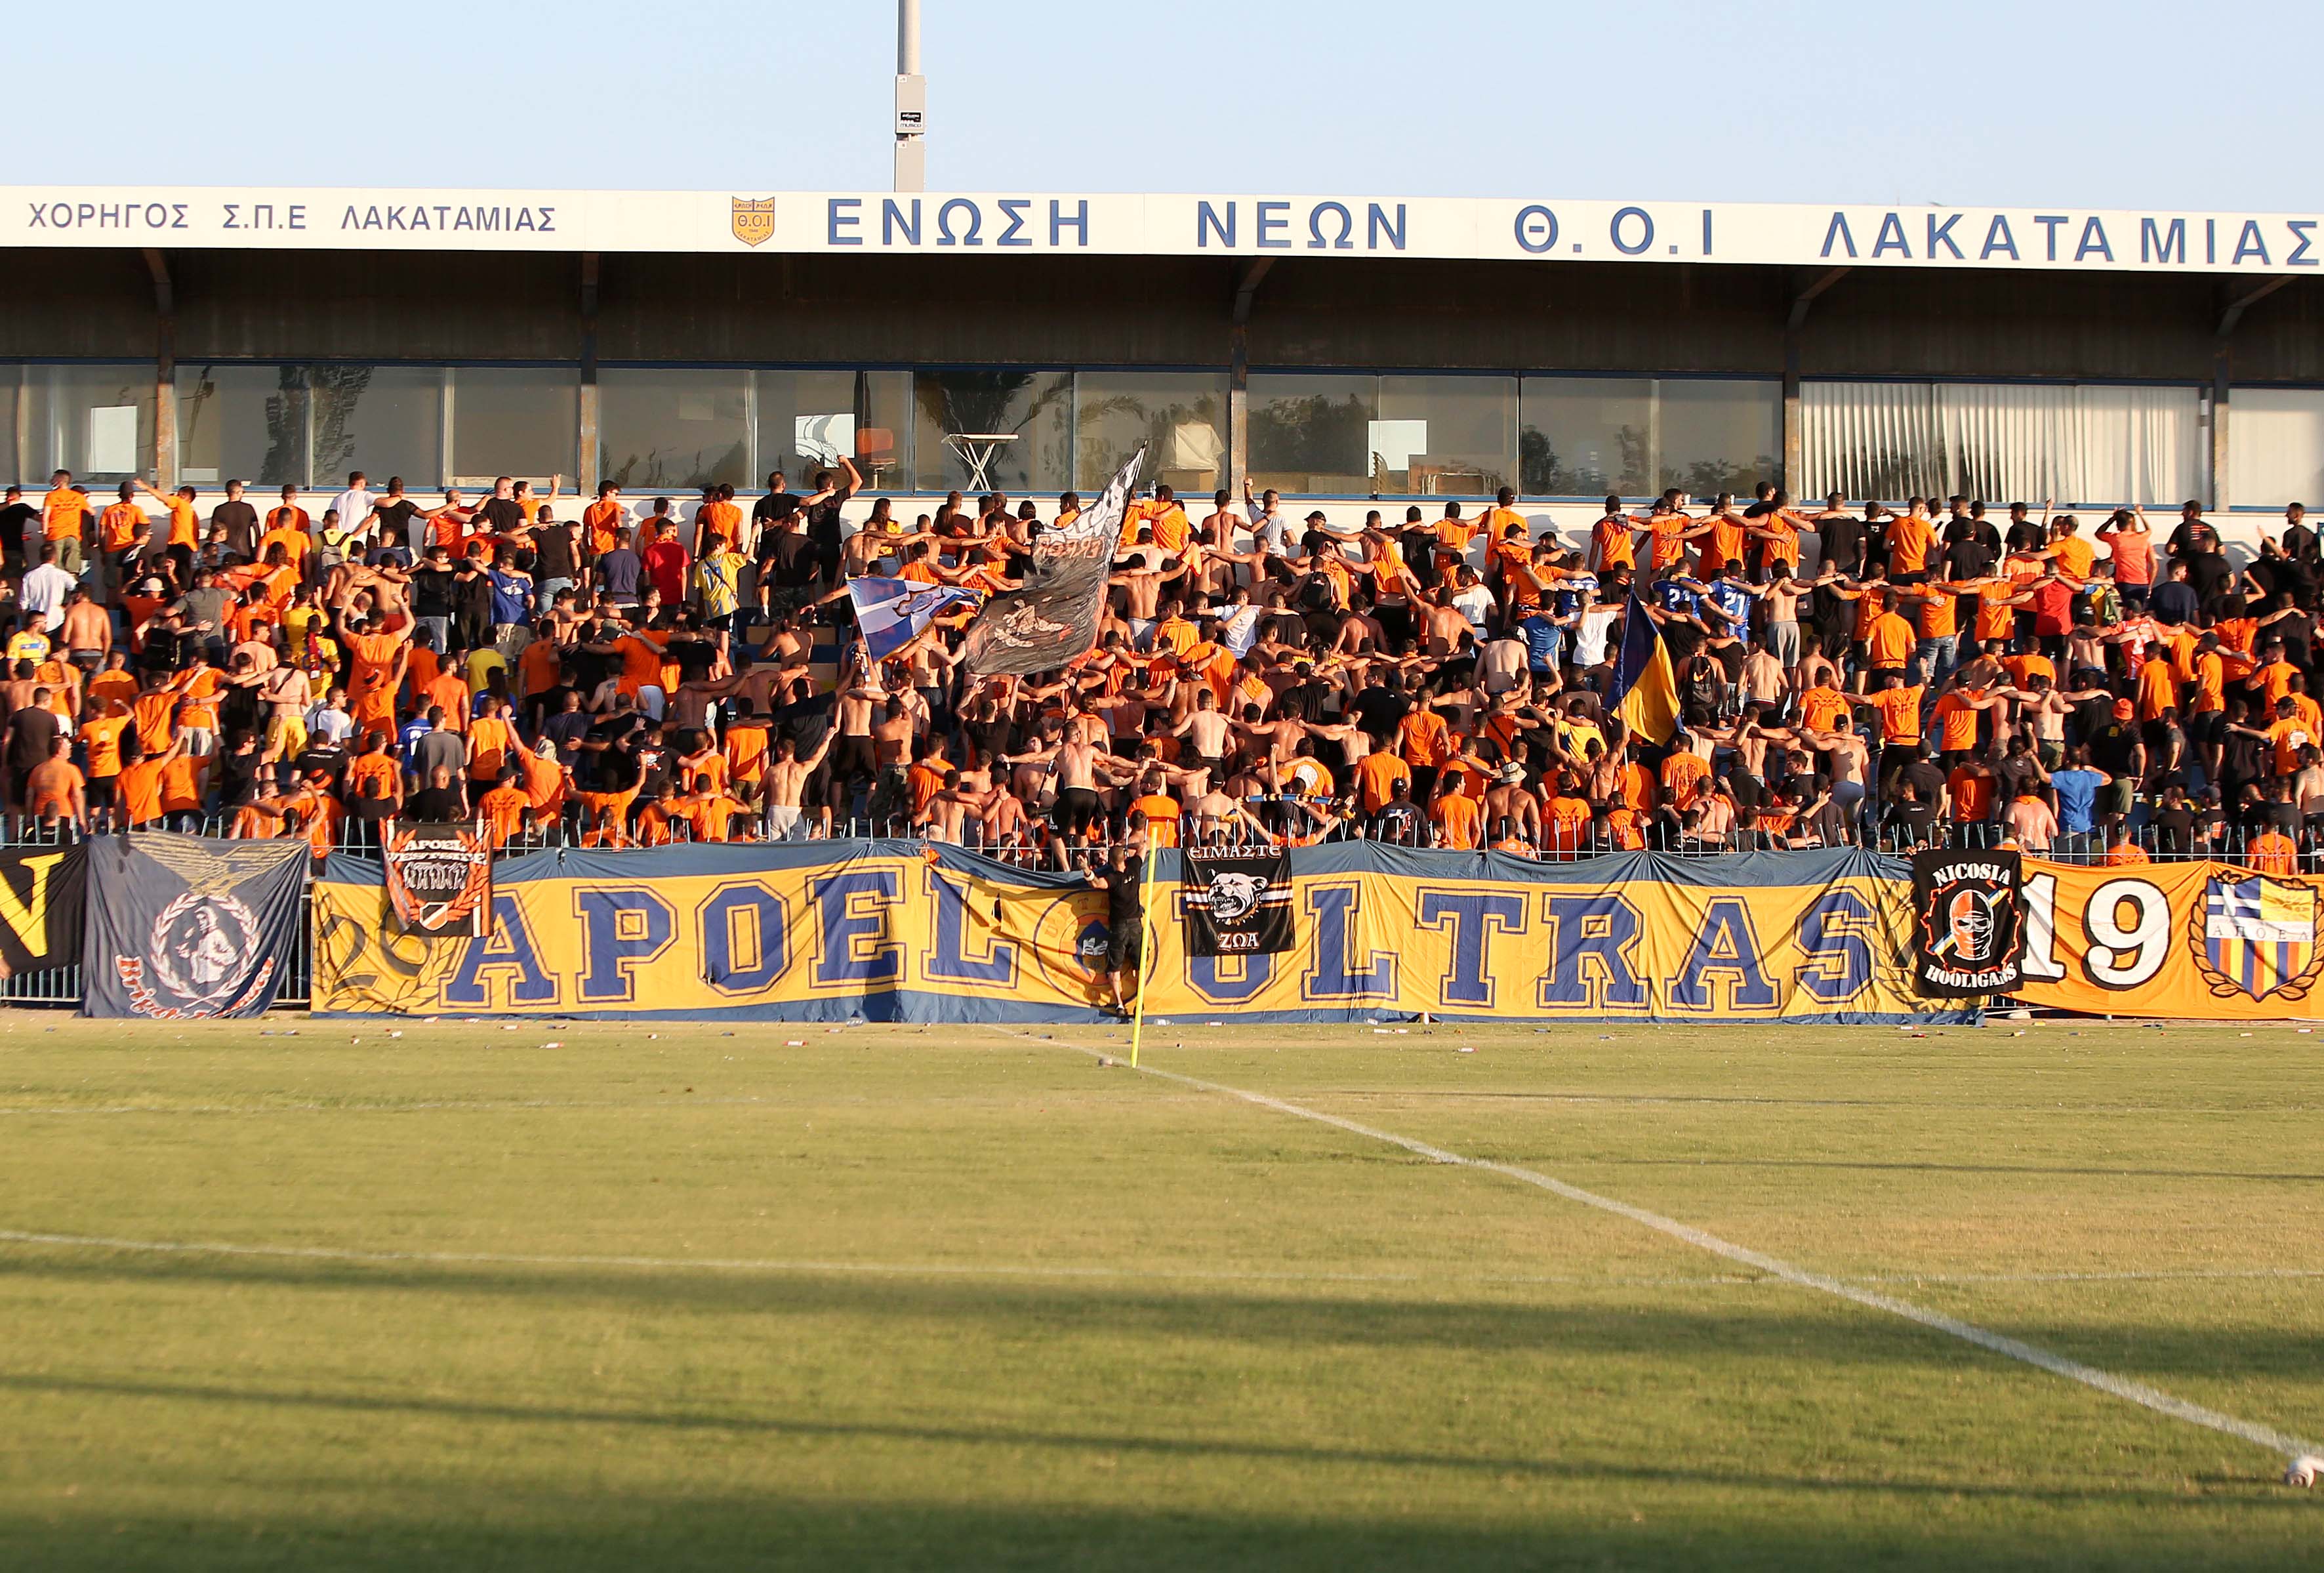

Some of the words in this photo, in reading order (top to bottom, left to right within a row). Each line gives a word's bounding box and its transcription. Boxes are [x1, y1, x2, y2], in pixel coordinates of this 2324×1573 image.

[28, 203, 190, 228] ΧΟΡΗΓΟΣ
[222, 205, 307, 230] Σ.Π.Ε
[340, 205, 556, 232] ΛΑΚΑΤΑΜΙΑΣ
[738, 214, 769, 227] Θ.Ο.Ι
[828, 198, 1088, 247] ΕΝΩΣΗ
[1197, 201, 1406, 250] ΝΕΩΝ
[1820, 211, 2320, 266] ΛΑΚΑΤΑΜΙΑΣ
[1723, 592, 1745, 616] 21
[404, 840, 468, 851] APOEL
[1932, 862, 2011, 887] NICOSIA
[439, 865, 1020, 1008] APOEL
[2020, 872, 2172, 991] 19
[1924, 962, 2017, 989] HOOLIGANS
